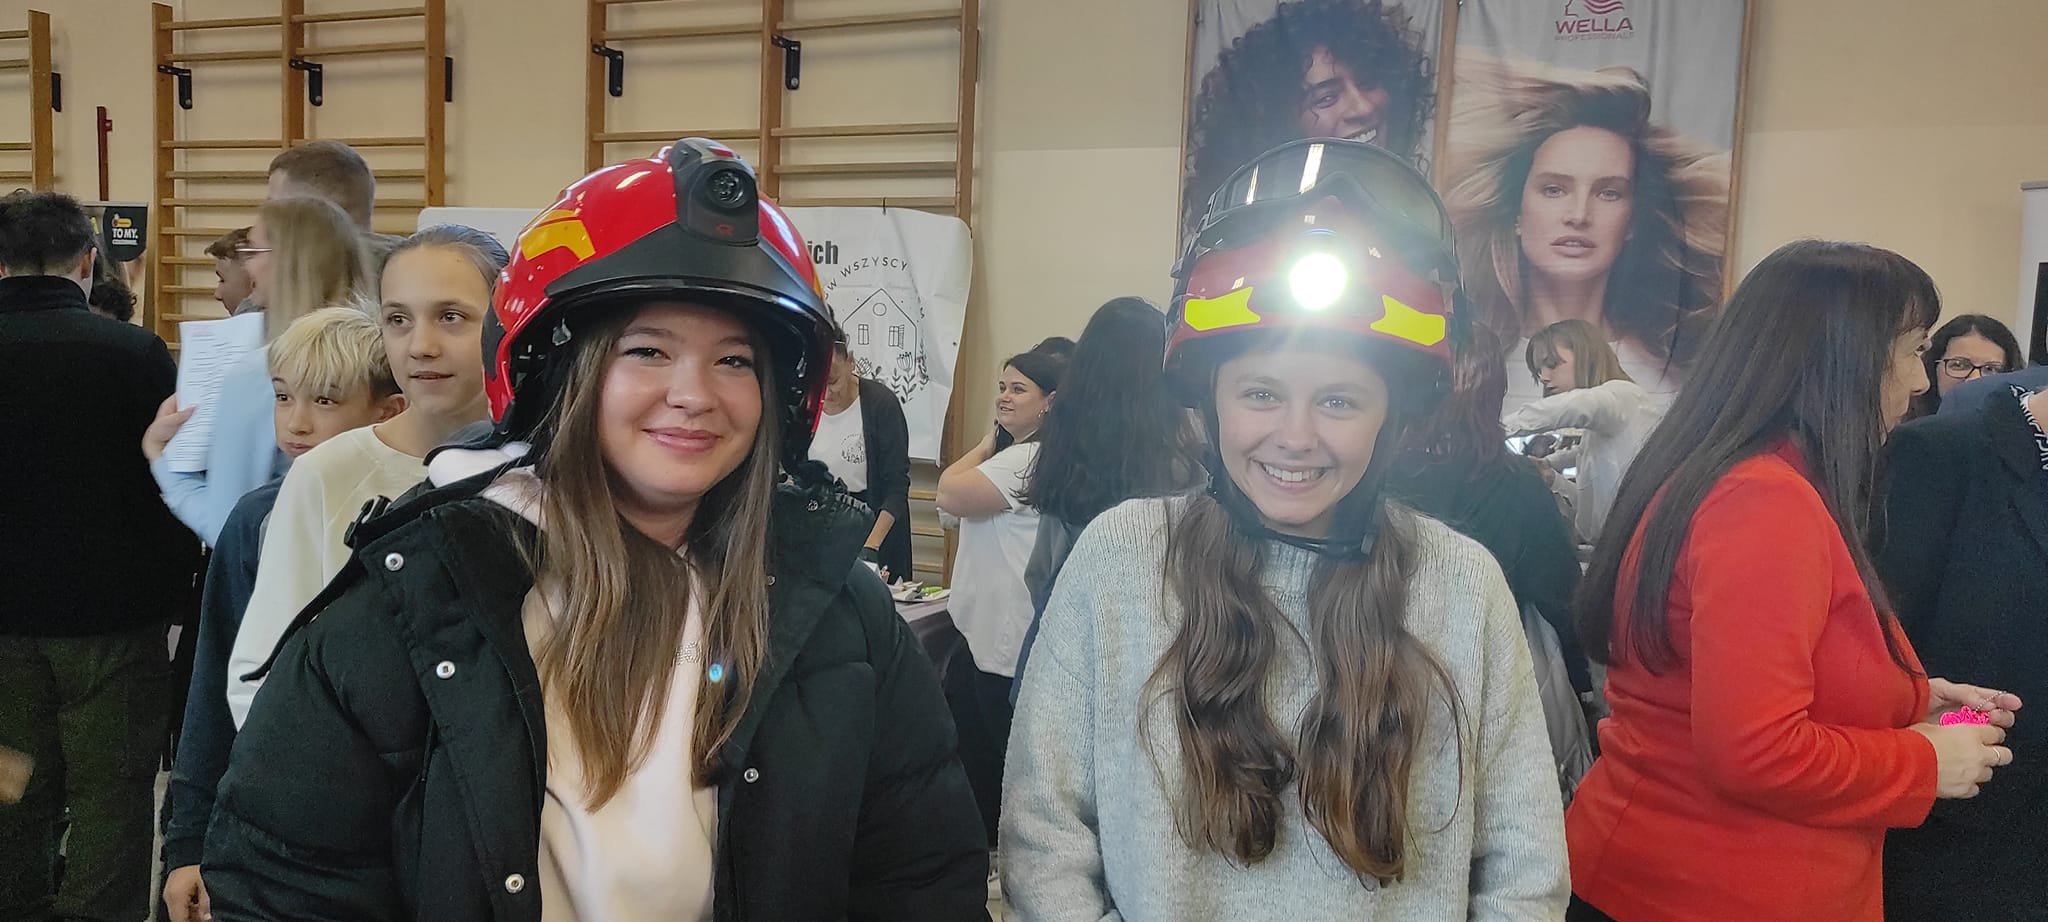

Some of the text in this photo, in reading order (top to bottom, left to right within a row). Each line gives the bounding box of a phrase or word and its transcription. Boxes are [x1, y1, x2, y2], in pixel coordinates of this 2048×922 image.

[1555, 18, 1633, 33] WELLA
[112, 228, 123, 238] TO
[840, 256, 908, 278] WSZYSCY
